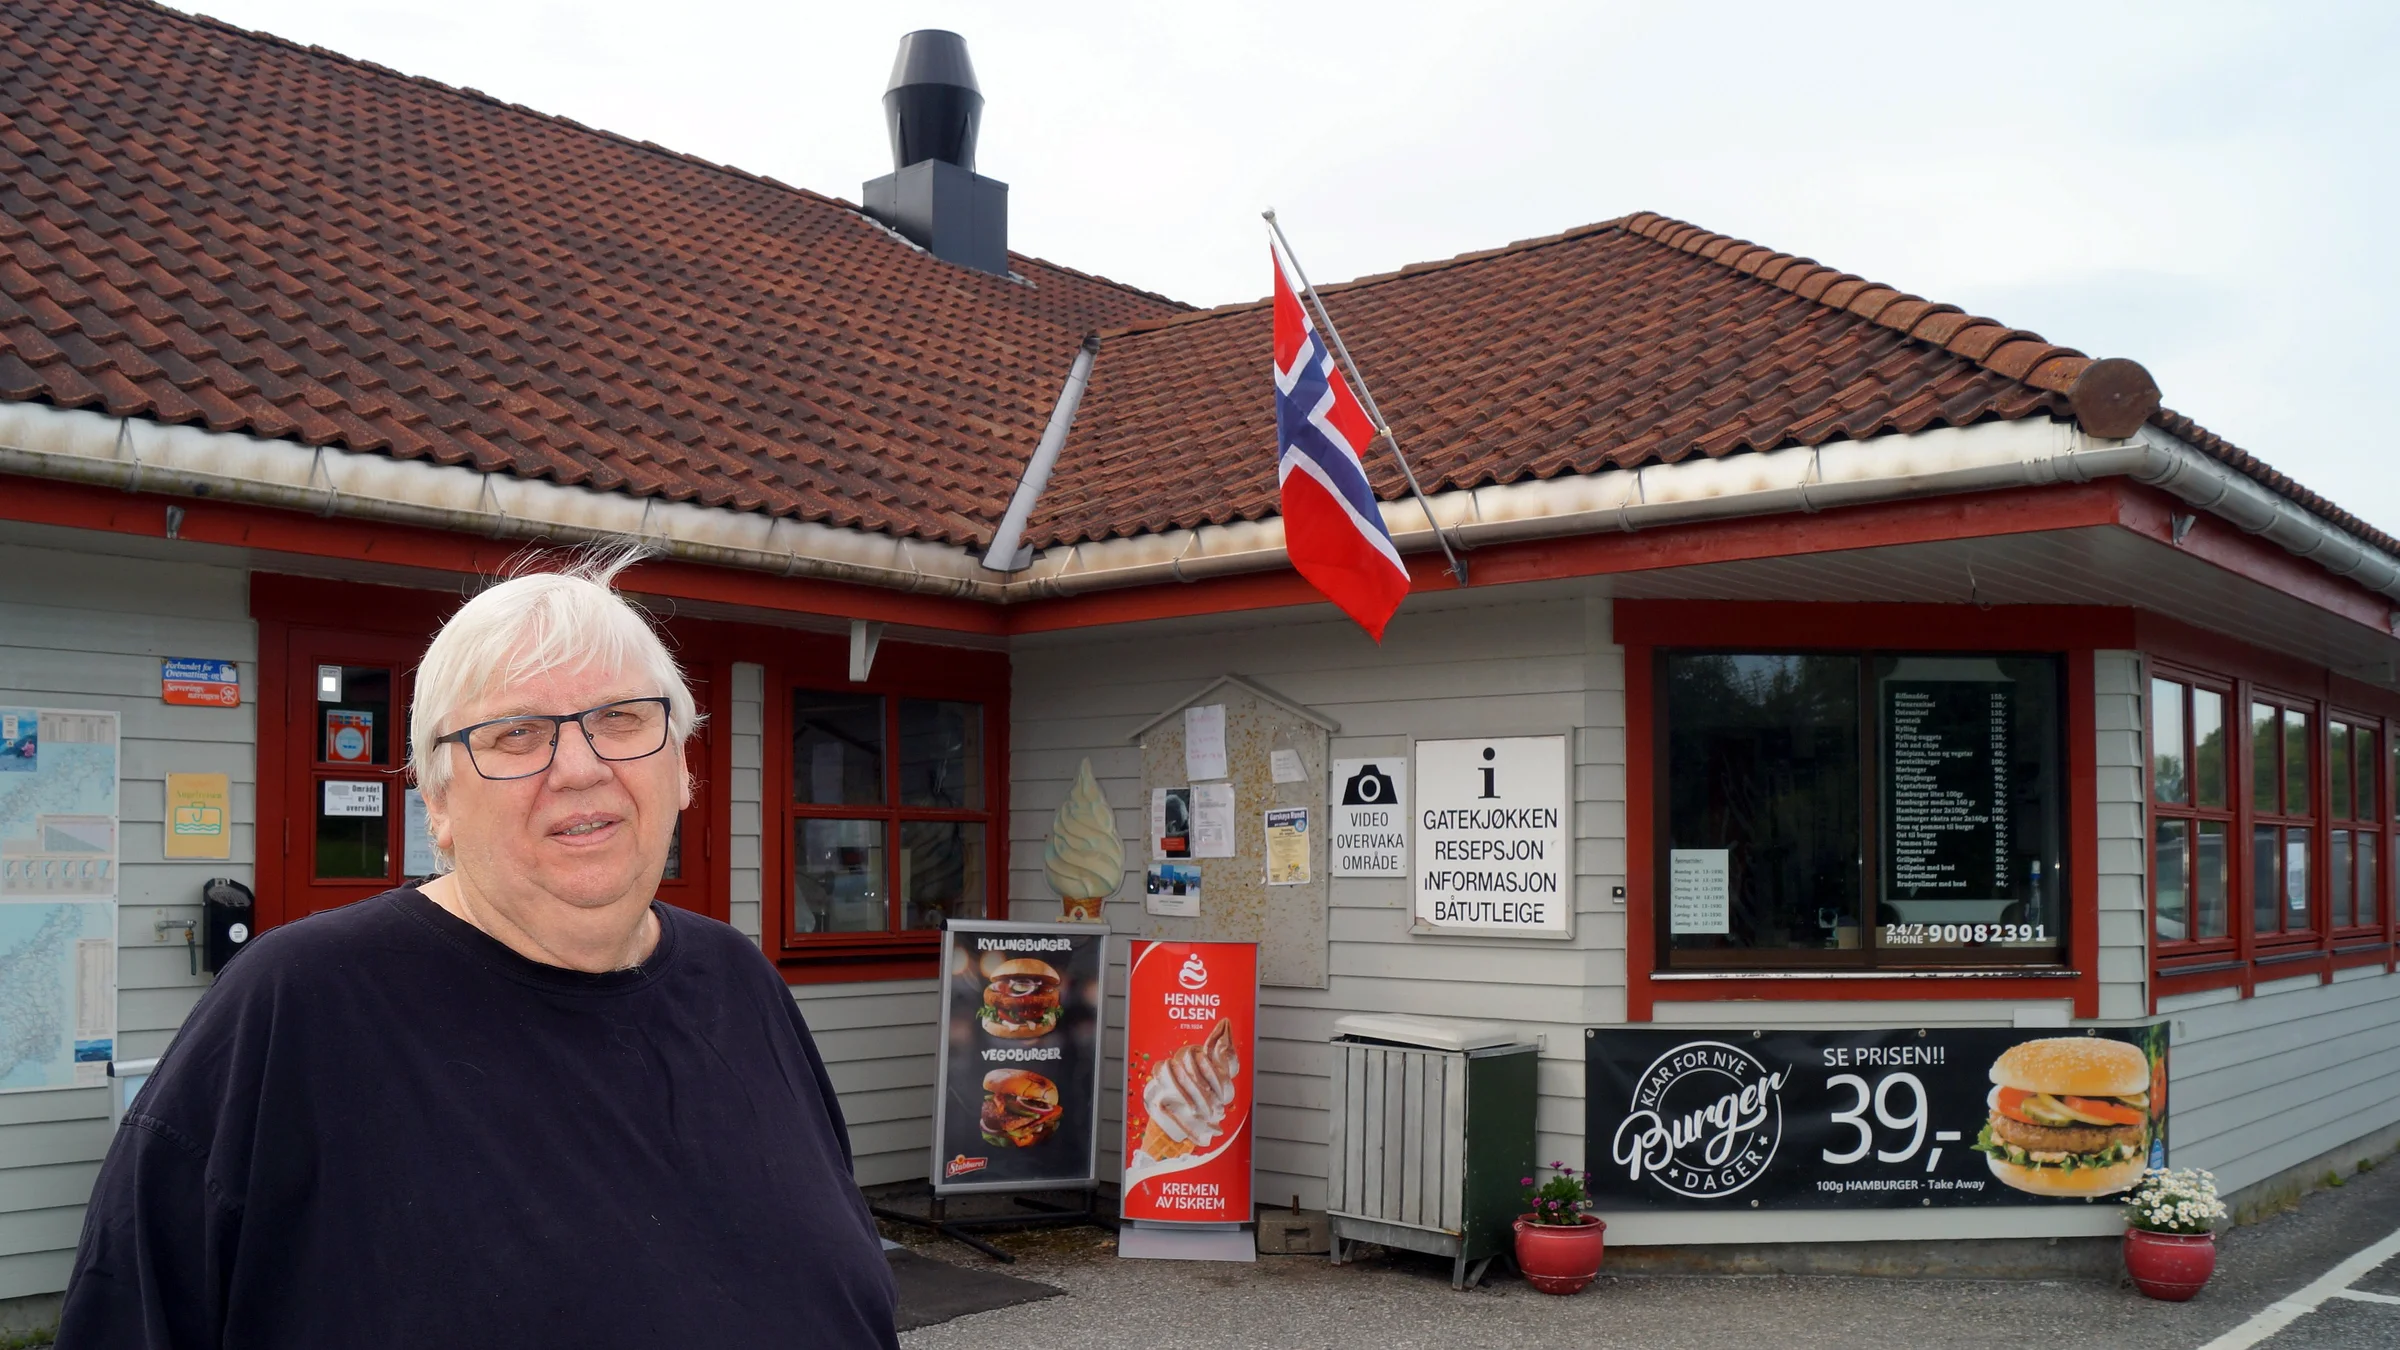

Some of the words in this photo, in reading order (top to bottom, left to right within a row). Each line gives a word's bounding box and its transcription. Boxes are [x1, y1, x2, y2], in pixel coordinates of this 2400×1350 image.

[202, 663, 213, 672] for
[1896, 799, 1929, 807] Hamburger
[1896, 807, 1929, 815] Hamburger
[1350, 812, 1389, 827] VIDEO
[1424, 808, 1558, 830] GATEKJØKKEN
[1337, 834, 1404, 849] OVERVAKA
[1435, 840, 1544, 860] RESEPSJON
[1343, 851, 1398, 870] OMRÅDE
[1425, 872, 1556, 893] INFORMASJON
[1435, 895, 1544, 923] BÅTUTLEIGE
[1886, 924, 1923, 935] 24/7
[978, 937, 1072, 952] KYLLINGBURGER
[1886, 935, 1923, 944] PHONE
[1164, 992, 1221, 1007] HENNIG
[1168, 1006, 1216, 1021] OLSEN
[981, 1047, 1062, 1062] VEGOBURGER
[1823, 1048, 1849, 1066] SE
[1856, 1046, 1945, 1066] PRISEN!!
[1641, 1066, 1674, 1106] KLAR
[1673, 1051, 1708, 1072] FOR
[1714, 1051, 1747, 1076] NYE
[1613, 1064, 1792, 1181] Burger
[1823, 1072, 1961, 1172] 39,-
[1685, 1150, 1763, 1189] DAGER
[1162, 1182, 1219, 1197] KREMEN
[1817, 1181, 1843, 1193] 100g
[1846, 1180, 1918, 1191] HAMBURGER
[1928, 1179, 1953, 1189] Take
[1955, 1179, 1985, 1191] Away
[1155, 1197, 1174, 1209] AV
[1175, 1196, 1225, 1210] ISKREM
